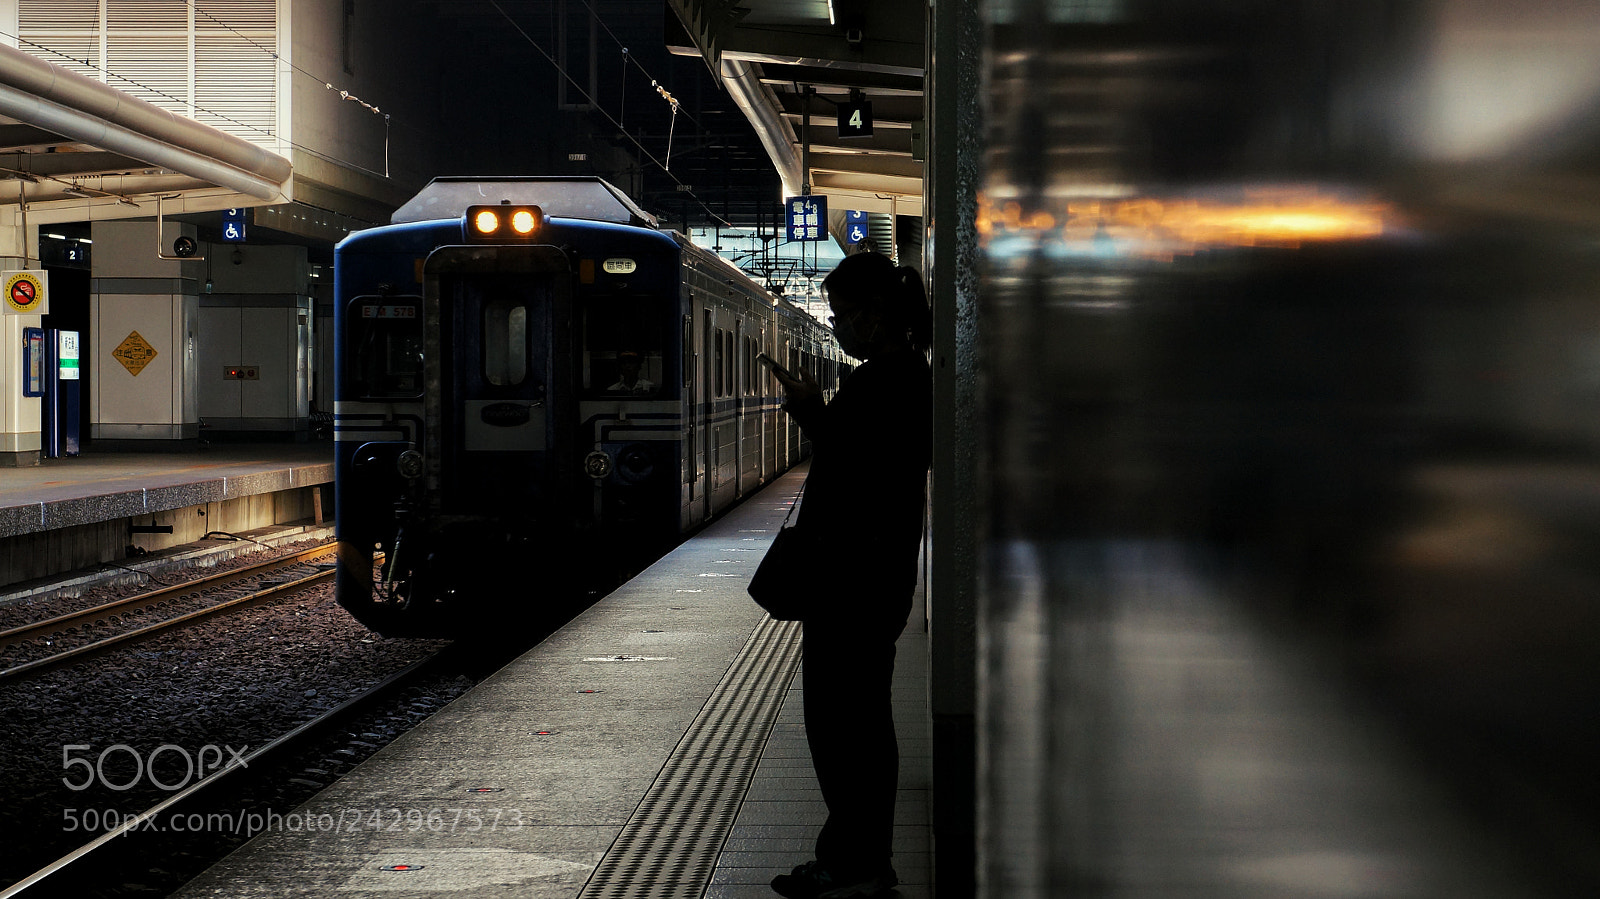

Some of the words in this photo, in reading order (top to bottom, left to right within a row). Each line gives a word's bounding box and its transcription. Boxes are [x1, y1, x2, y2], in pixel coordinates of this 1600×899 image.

[849, 109, 862, 129] 4
[69, 250, 75, 260] 2
[394, 307, 414, 317] 578
